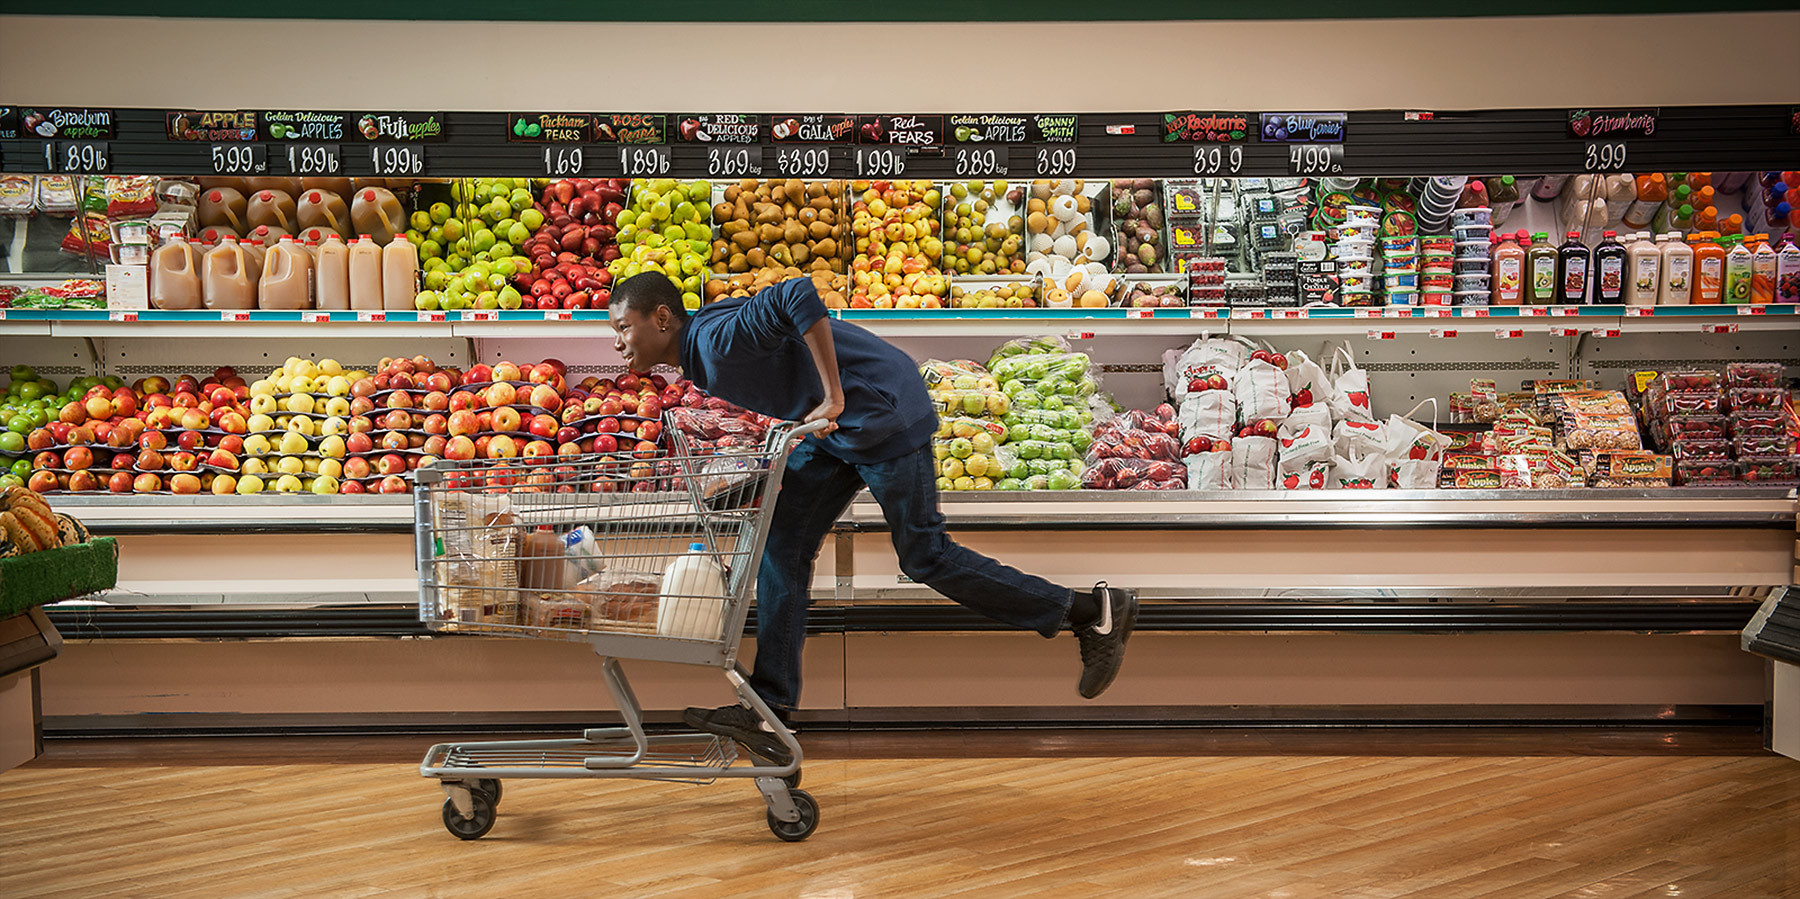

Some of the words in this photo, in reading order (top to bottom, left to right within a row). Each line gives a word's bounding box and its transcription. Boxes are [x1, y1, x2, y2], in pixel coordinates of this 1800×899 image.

[49, 109, 110, 127] Braeburn
[200, 112, 255, 128] APPLE
[265, 111, 293, 122] Golden
[294, 111, 343, 122] Delicious
[611, 114, 654, 127] BOSC
[715, 114, 739, 124] RED
[890, 115, 925, 130] Red
[951, 115, 978, 125] Golden
[979, 114, 1026, 125] Delicious
[1037, 116, 1075, 128] GRANNY
[1166, 115, 1187, 134] RED
[1187, 113, 1247, 134] Raspberries
[1592, 112, 1655, 136] Strawberries
[63, 125, 108, 138] apples
[301, 123, 343, 140] APPLES
[378, 115, 409, 139] Fuji
[408, 116, 441, 140] apples
[544, 129, 580, 140] PEARS
[707, 123, 758, 136] DELICIOUS
[799, 124, 834, 141] GALA
[831, 118, 854, 138] apples
[985, 125, 1026, 142] APPLES
[716, 134, 752, 144] APPLES
[888, 130, 934, 144] PEARS
[212, 146, 254, 173] 5.99
[544, 147, 583, 174] 1.69
[708, 149, 749, 175] 3.69
[778, 149, 829, 175] $3.99
[956, 149, 996, 175] 3.89
[1037, 149, 1076, 175] 3.99
[1291, 147, 1331, 173] 4.99
[1585, 144, 1626, 170] 3.99
[1622, 463, 1655, 473] Apples
